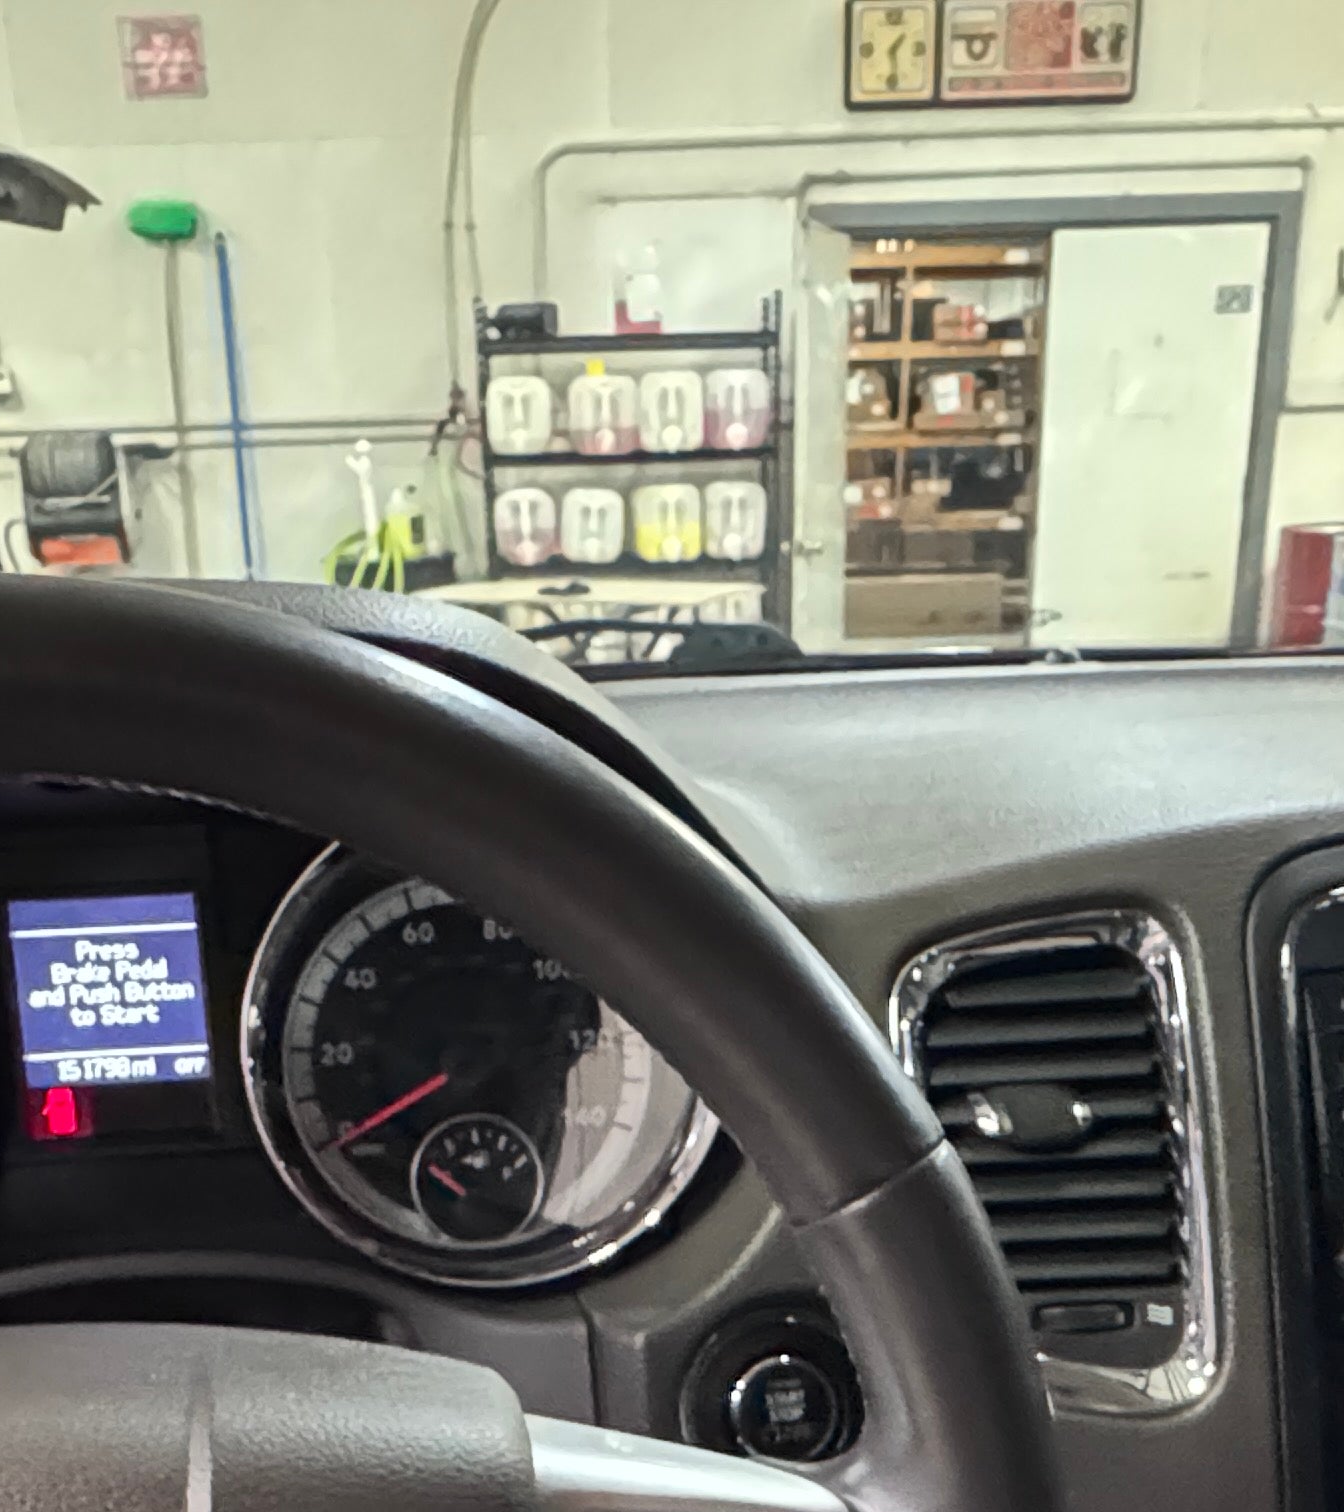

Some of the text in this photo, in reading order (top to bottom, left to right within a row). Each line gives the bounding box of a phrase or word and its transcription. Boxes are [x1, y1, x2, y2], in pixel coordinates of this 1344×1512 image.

[402, 922, 434, 944] 60
[75, 941, 139, 961] Press
[50, 957, 168, 984] Brake Pedal
[28, 981, 195, 1008] and Push Button
[69, 1004, 160, 1027] to Start
[320, 1043, 354, 1066] 20
